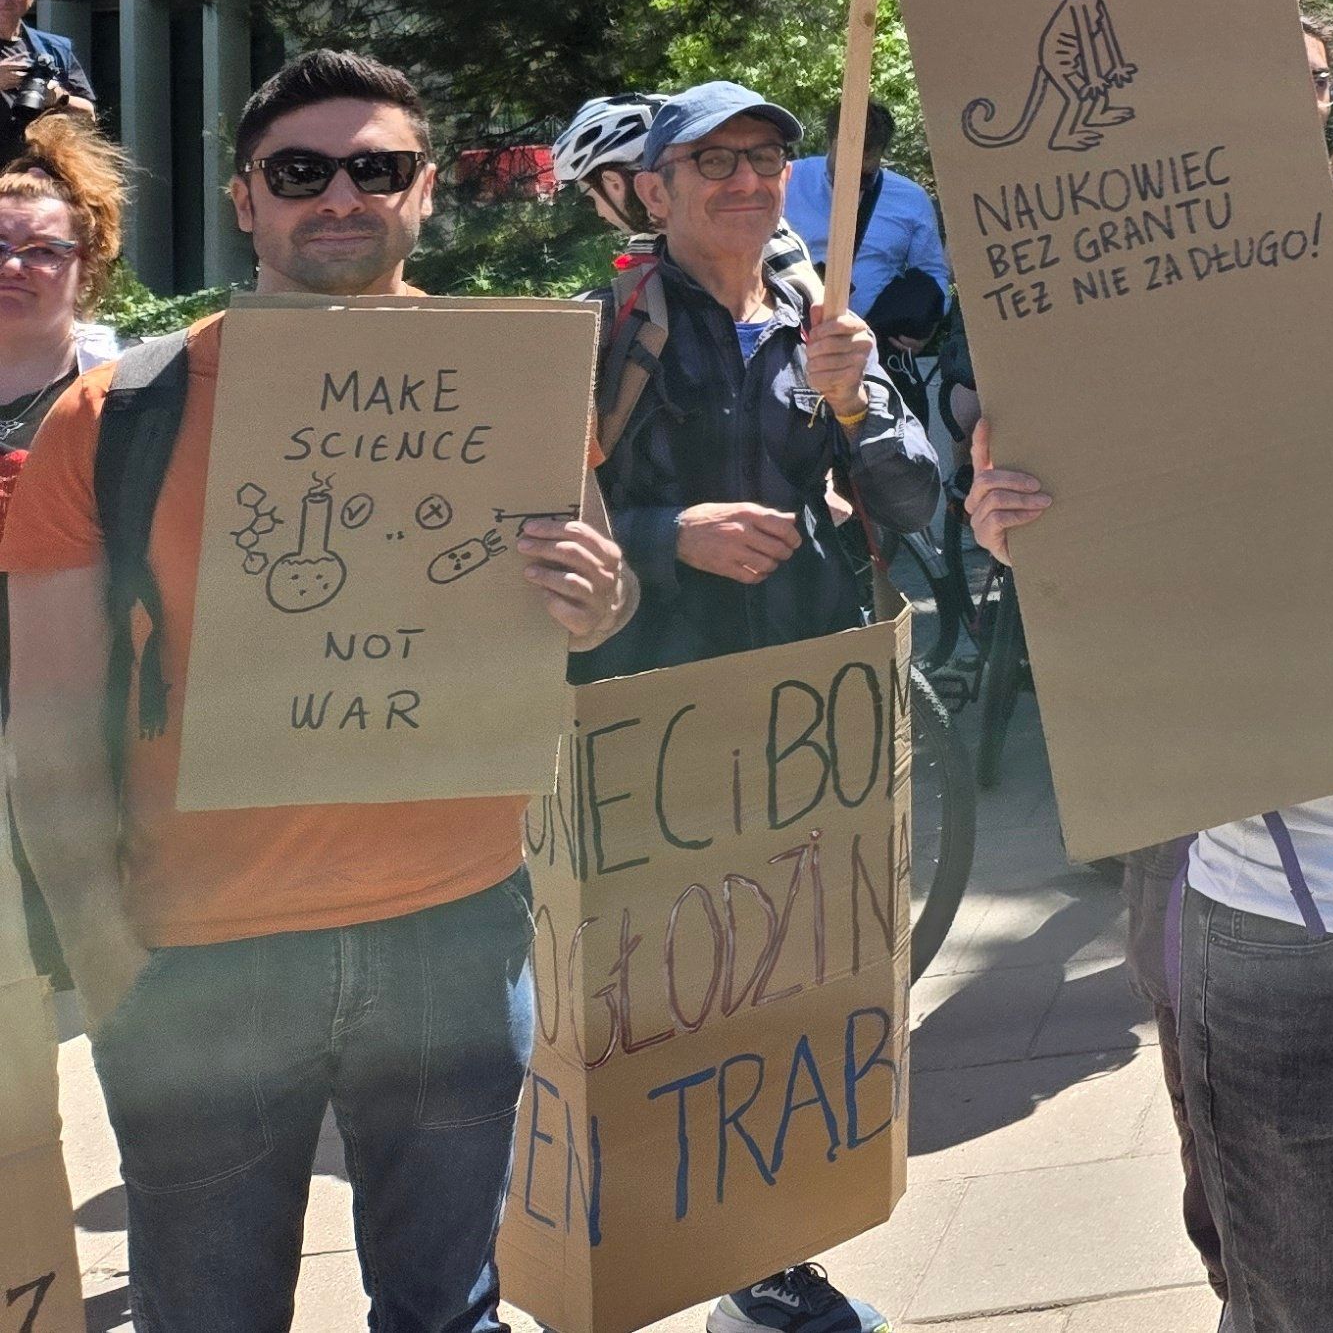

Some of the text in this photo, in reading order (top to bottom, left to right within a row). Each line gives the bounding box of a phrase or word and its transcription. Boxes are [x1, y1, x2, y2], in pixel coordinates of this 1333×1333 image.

[973, 146, 1230, 236] NAUKOWIEC
[986, 192, 1232, 279] BEZ GRANTU
[1072, 267, 1131, 305] NIE
[1188, 212, 1322, 281] DŁUGO!
[320, 369, 461, 415] MAKE
[284, 425, 492, 464] SCIENCE
[325, 628, 425, 660] NOT
[291, 690, 421, 730] WAR
[524, 1006, 900, 1247] EN TRĄB
